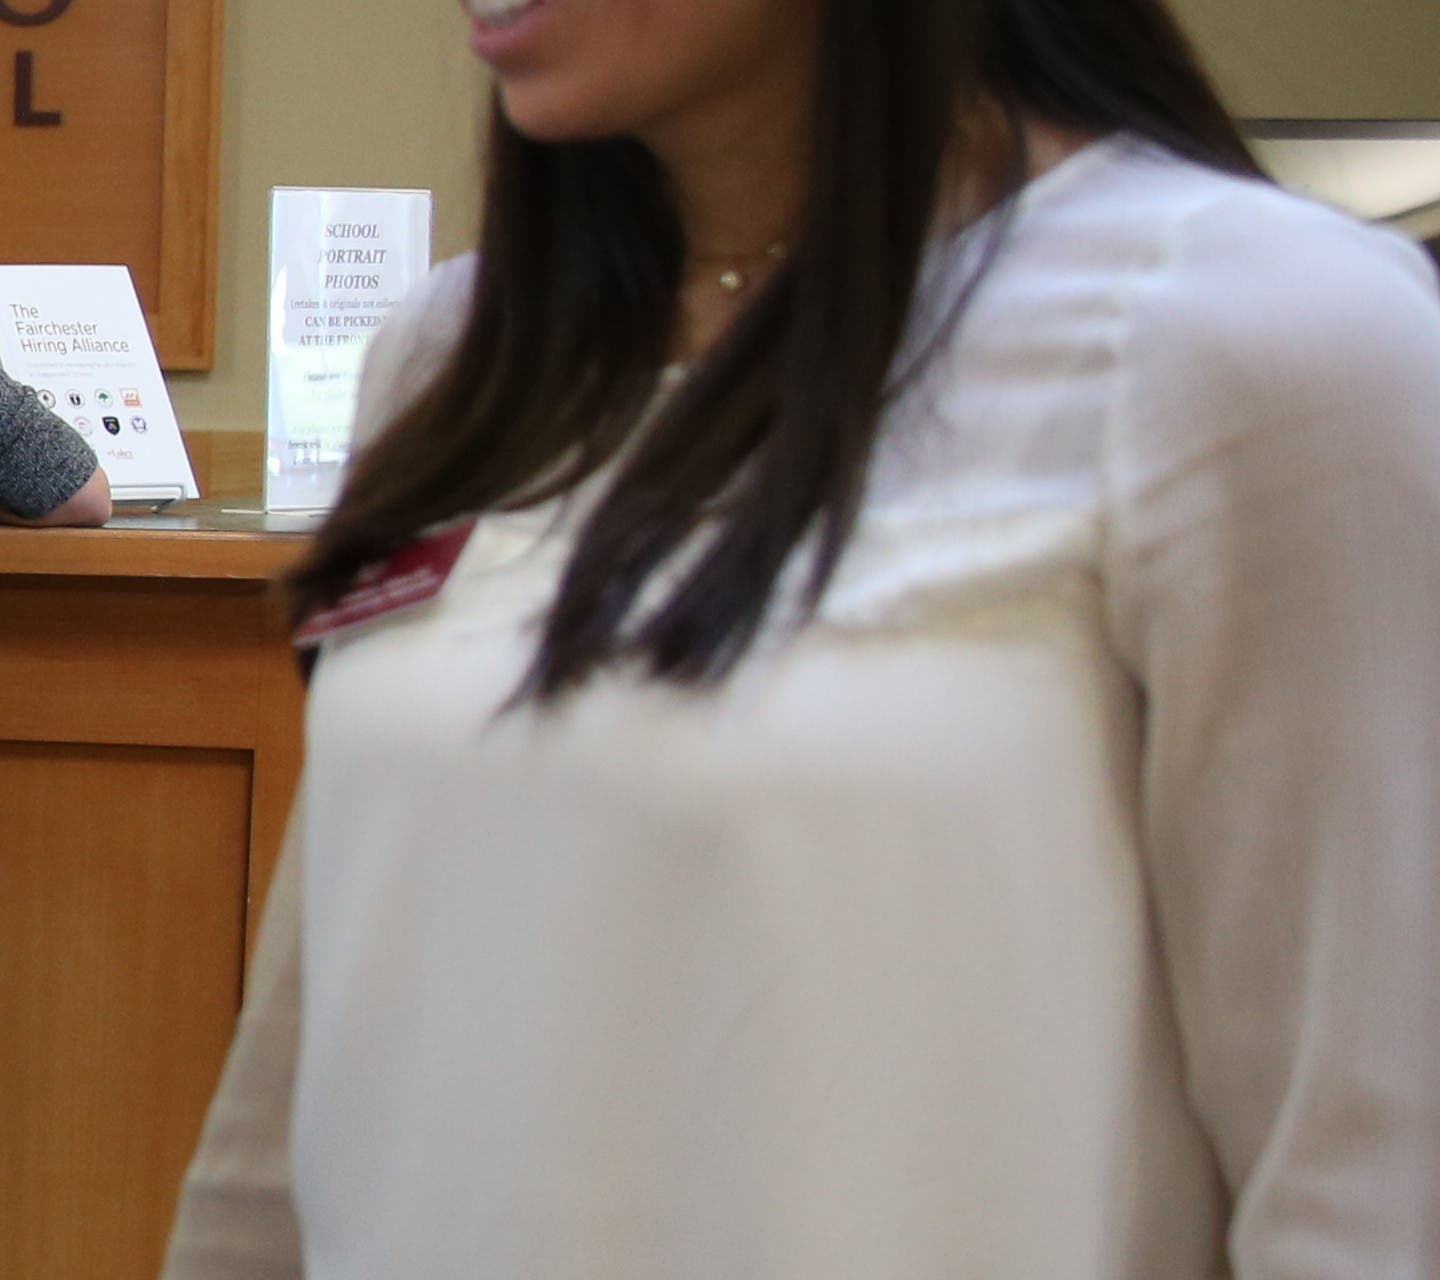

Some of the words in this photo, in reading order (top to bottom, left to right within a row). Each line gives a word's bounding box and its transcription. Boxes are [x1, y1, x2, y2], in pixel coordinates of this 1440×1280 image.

[324, 223, 381, 239] SCHOOL
[318, 249, 387, 265] PORTRAIT
[324, 274, 380, 290] PHOTOS
[9, 303, 39, 319] The
[15, 321, 98, 336] Fairchester
[305, 315, 326, 328] CAN
[328, 315, 341, 328] BE
[343, 315, 381, 328] PICKED
[21, 338, 68, 355] Hiring
[72, 337, 130, 353] Alliance
